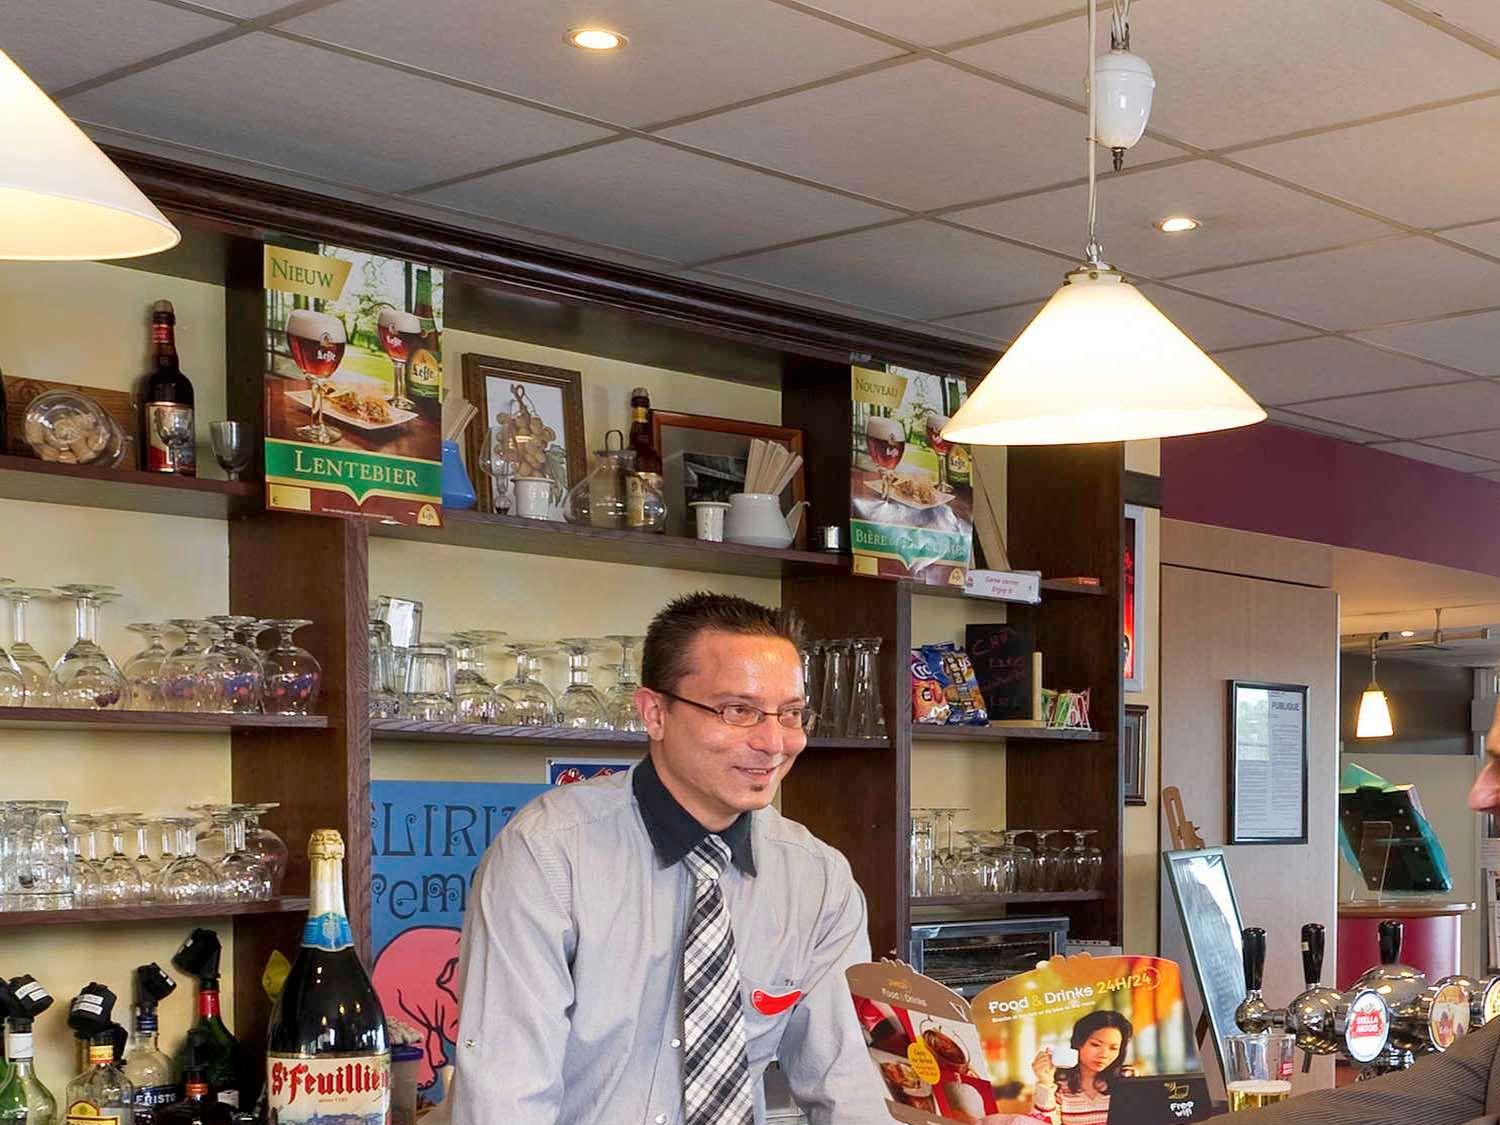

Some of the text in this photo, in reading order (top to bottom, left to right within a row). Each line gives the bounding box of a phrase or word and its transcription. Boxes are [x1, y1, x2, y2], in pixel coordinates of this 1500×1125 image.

[294, 449, 418, 488] LENTEBIER
[1271, 701, 1300, 712] PUBLIQUE
[988, 996, 1029, 1014] Food
[1031, 993, 1042, 1007] &
[1044, 985, 1094, 1005] Drinks
[1096, 974, 1152, 995] 24H/24
[1170, 1101, 1195, 1112] Free
